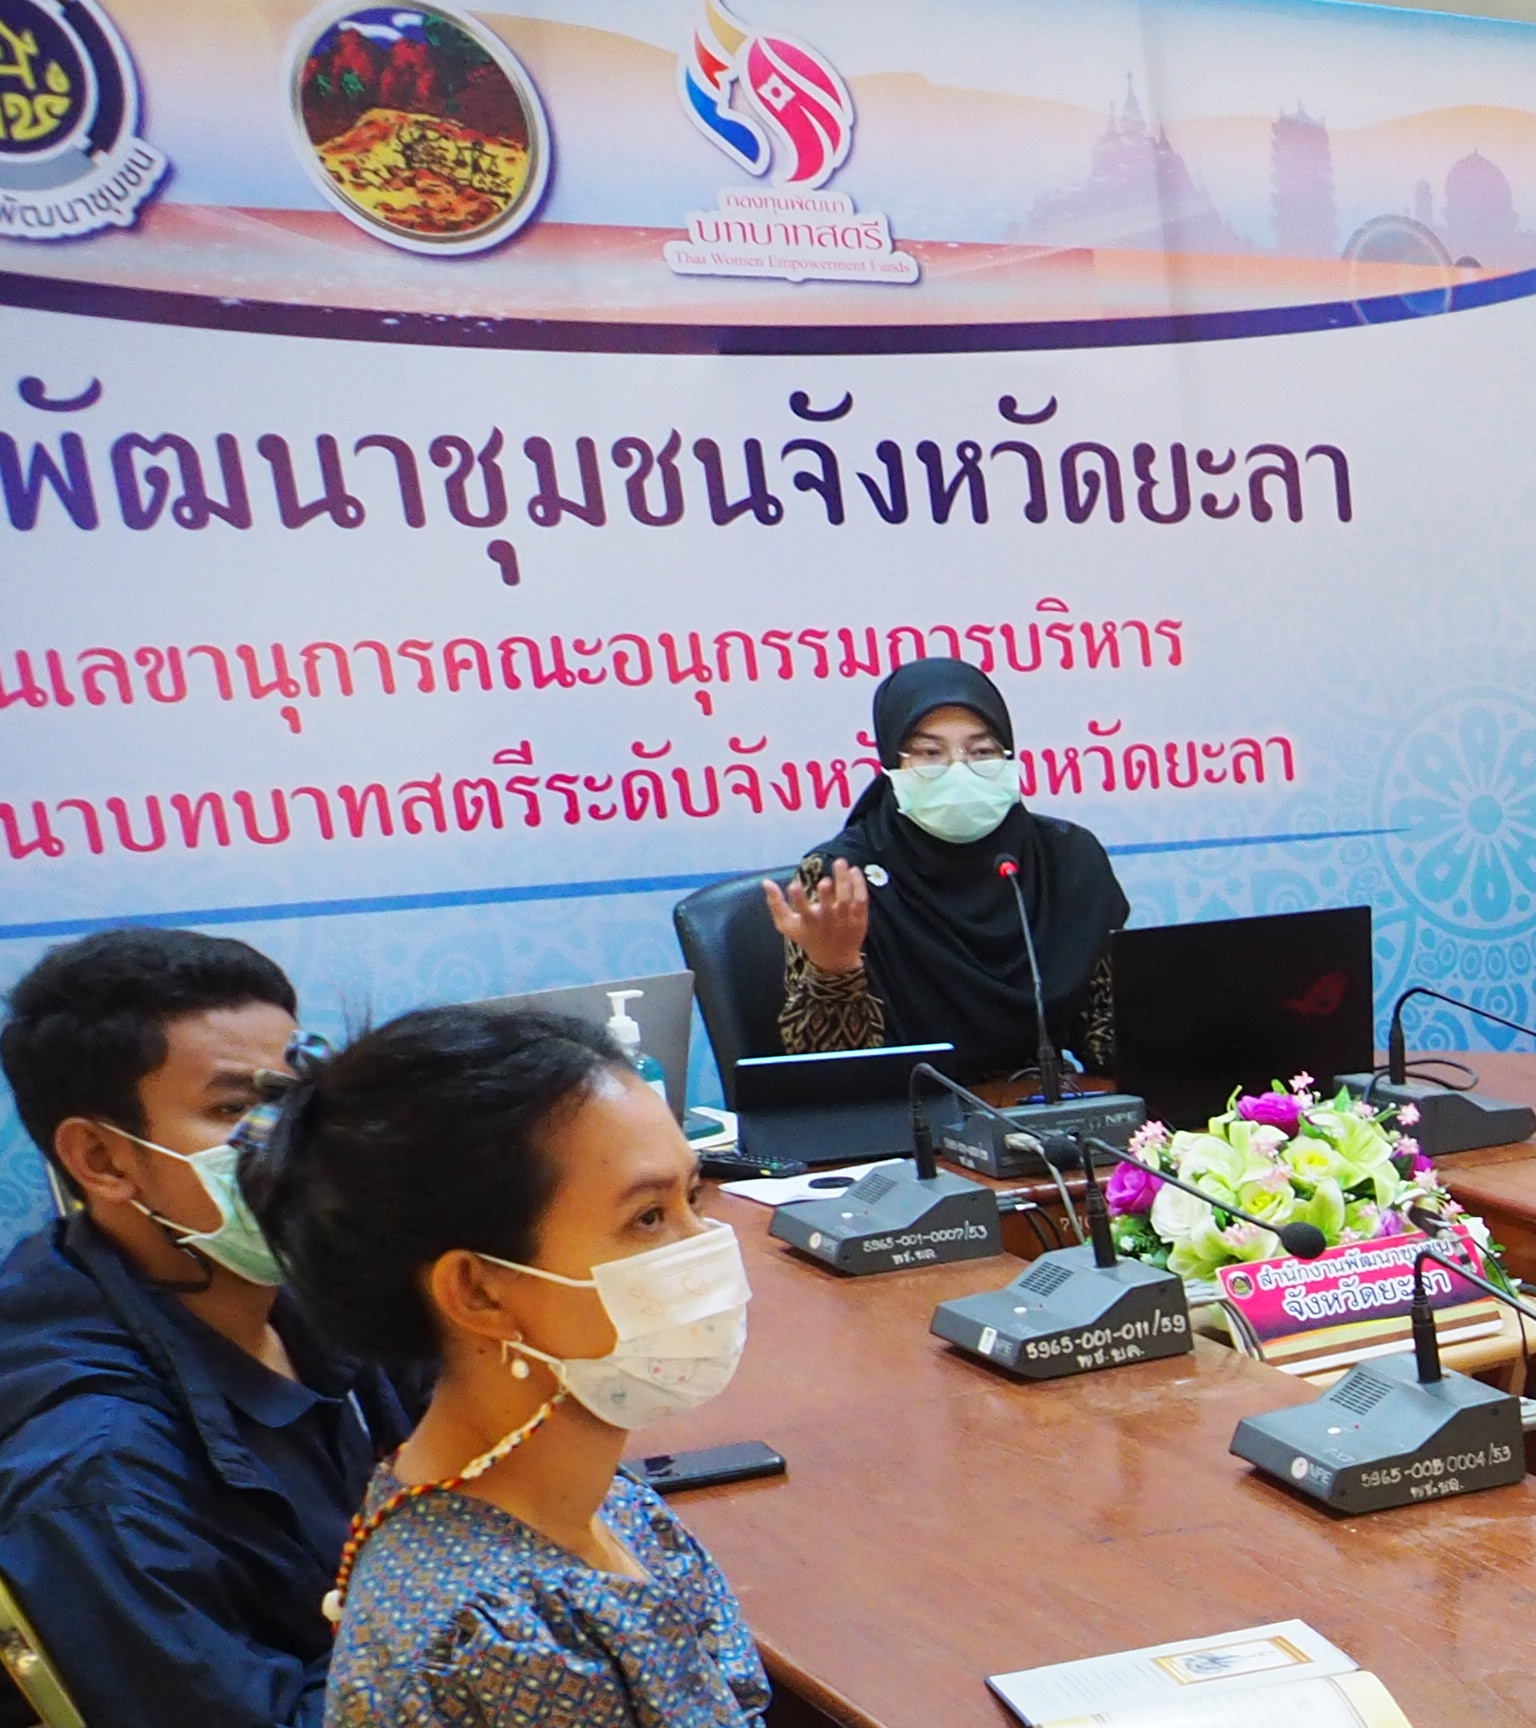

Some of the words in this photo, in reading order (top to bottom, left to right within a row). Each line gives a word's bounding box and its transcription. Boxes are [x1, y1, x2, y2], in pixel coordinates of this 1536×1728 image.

[696, 219, 884, 250] บทบาทสตรี
[676, 251, 707, 265] Thai
[712, 252, 764, 268] Women
[768, 256, 866, 272] Empowerment
[0, 376, 1353, 586] พัฒนาชุมชนจังหวัดยะลา
[1026, 1309, 1187, 1360] 5965-001-011/59
